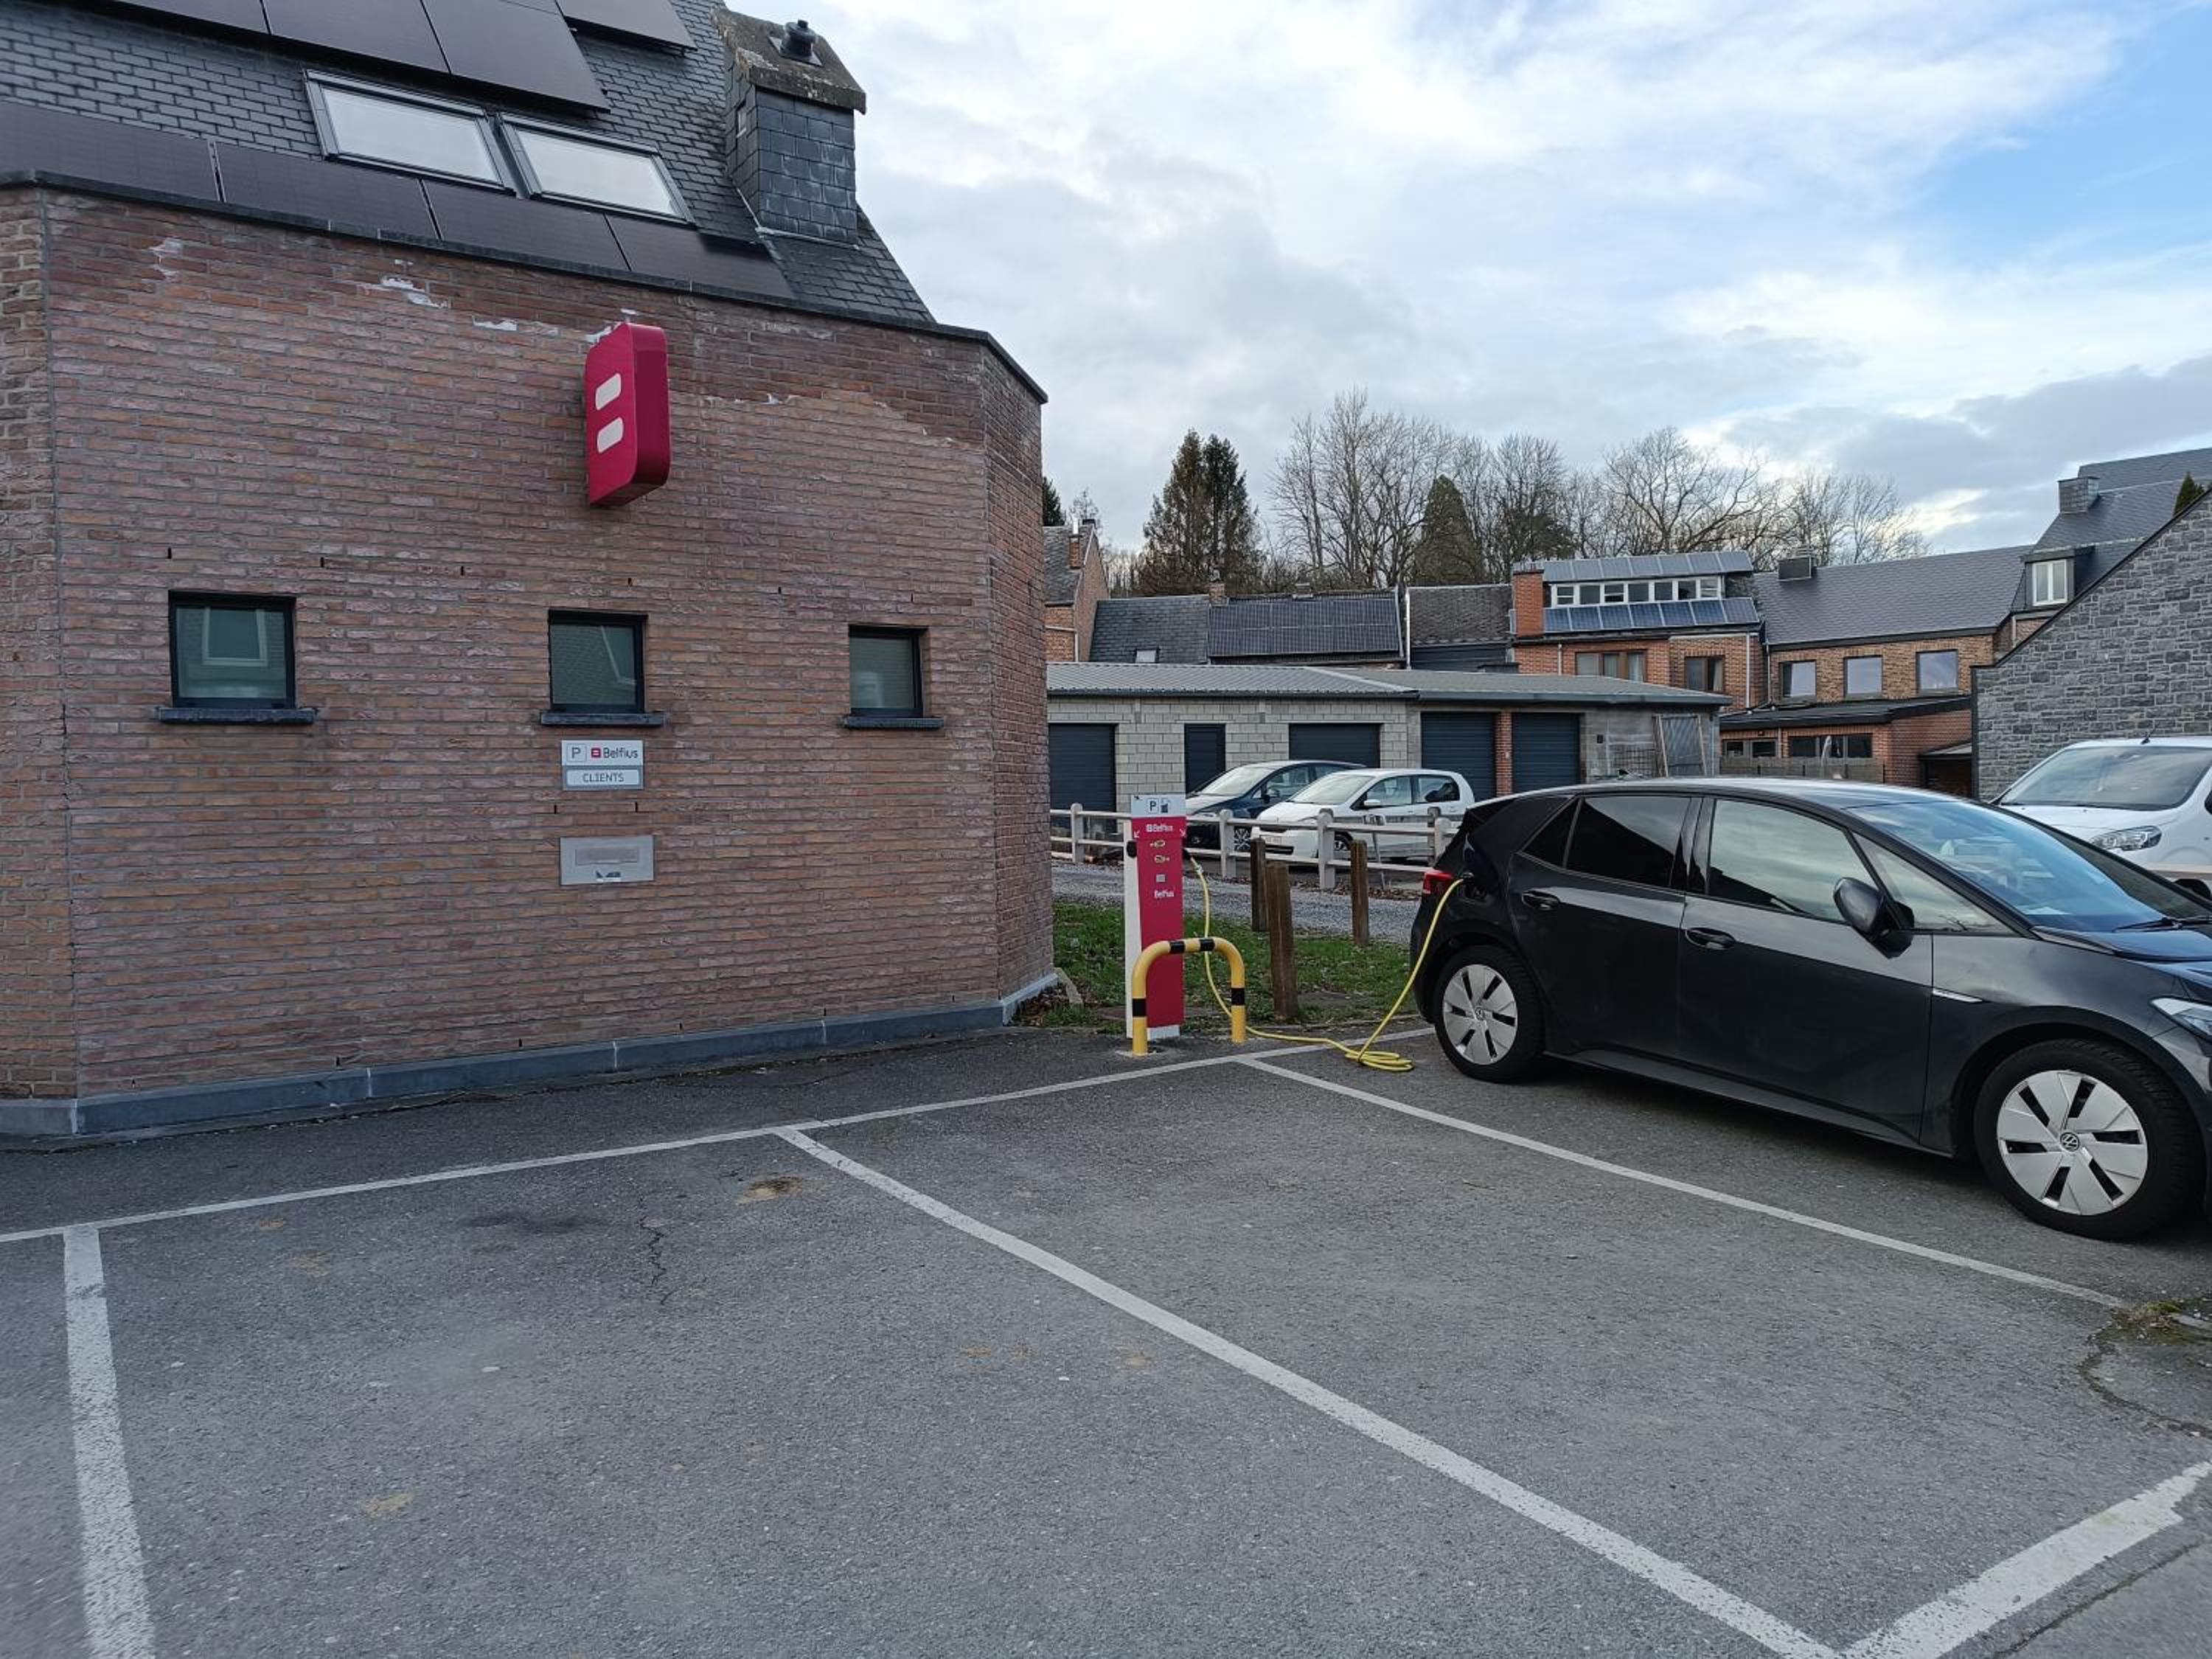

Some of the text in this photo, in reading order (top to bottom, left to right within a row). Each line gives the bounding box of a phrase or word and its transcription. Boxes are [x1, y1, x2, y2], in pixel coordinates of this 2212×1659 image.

[571, 747, 638, 759] P Belfius
[582, 773, 625, 783] CLIENTS
[1150, 801, 1157, 812] P
